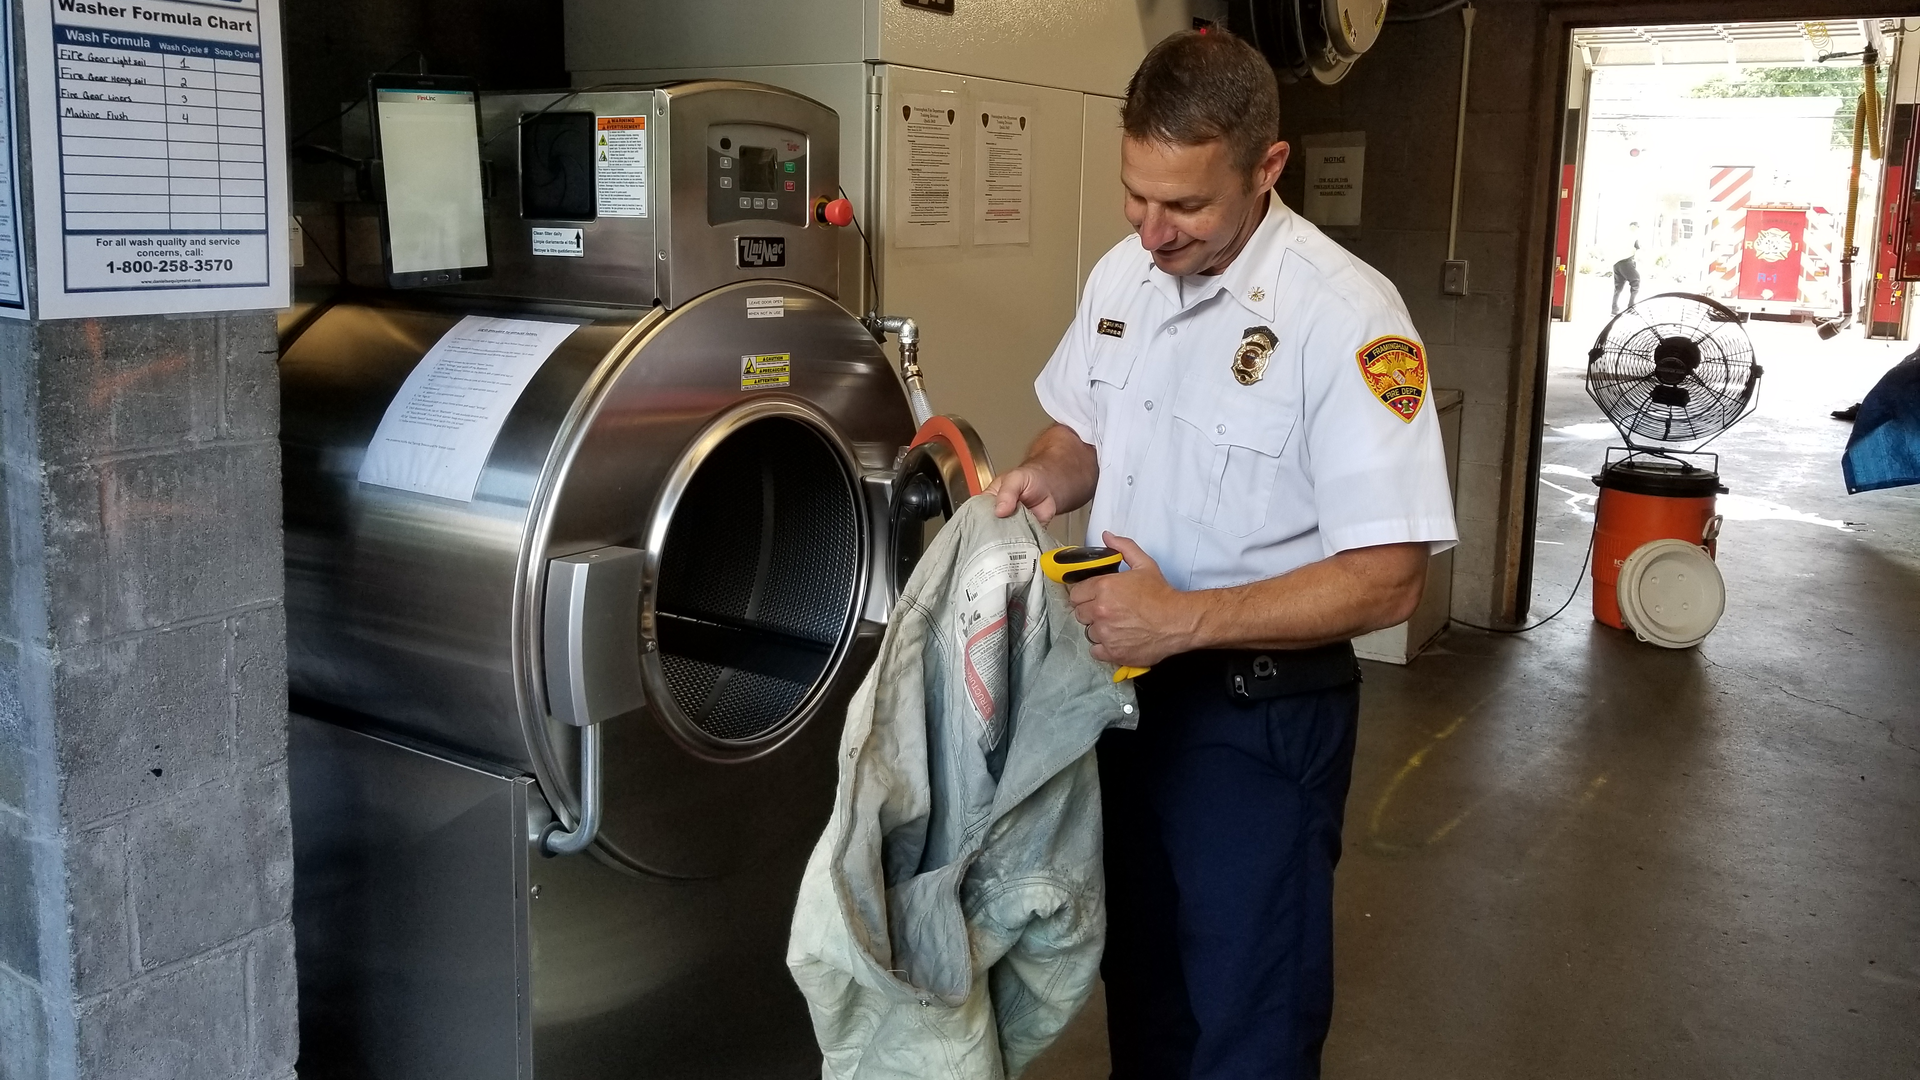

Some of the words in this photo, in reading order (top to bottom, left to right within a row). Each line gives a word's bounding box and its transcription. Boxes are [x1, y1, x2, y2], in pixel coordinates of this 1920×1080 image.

[58, 0, 126, 18] Washer
[132, 6, 202, 26] Formula
[207, 15, 252, 32] Chart
[66, 29, 100, 43] Wash
[102, 33, 150, 48] Formula
[158, 42, 180, 51] Wash
[182, 44, 202, 54] Cycle
[214, 48, 233, 58] Soap
[234, 50, 254, 58] Cycle
[88, 53, 110, 63] Gear
[112, 56, 131, 68] Light
[180, 58, 190, 68] 1
[60, 67, 84, 80] Fire
[88, 73, 109, 82] Gear
[111, 76, 131, 86] Heavy
[181, 78, 187, 88] 2
[60, 88, 78, 98] Fire
[83, 91, 104, 100] Gear
[181, 95, 188, 103] 3
[65, 107, 100, 119] Machine
[107, 111, 129, 120] Flush
[182, 114, 188, 123] 4
[96, 238, 113, 246] For
[115, 238, 127, 246] all
[129, 238, 153, 246] wash
[156, 238, 187, 248] quality
[190, 238, 206, 246] and
[1745, 241, 1753, 250] R
[1795, 242, 1799, 251] 1
[185, 248, 203, 256] call:
[740, 239, 783, 265] UniMac
[106, 259, 233, 273] 1-800-258-3570
[1758, 273, 1777, 283] R-1
[1372, 343, 1409, 357] FRAMINGHAM
[1386, 389, 1400, 400] FIRE
[1402, 387, 1418, 395] DEPT.
